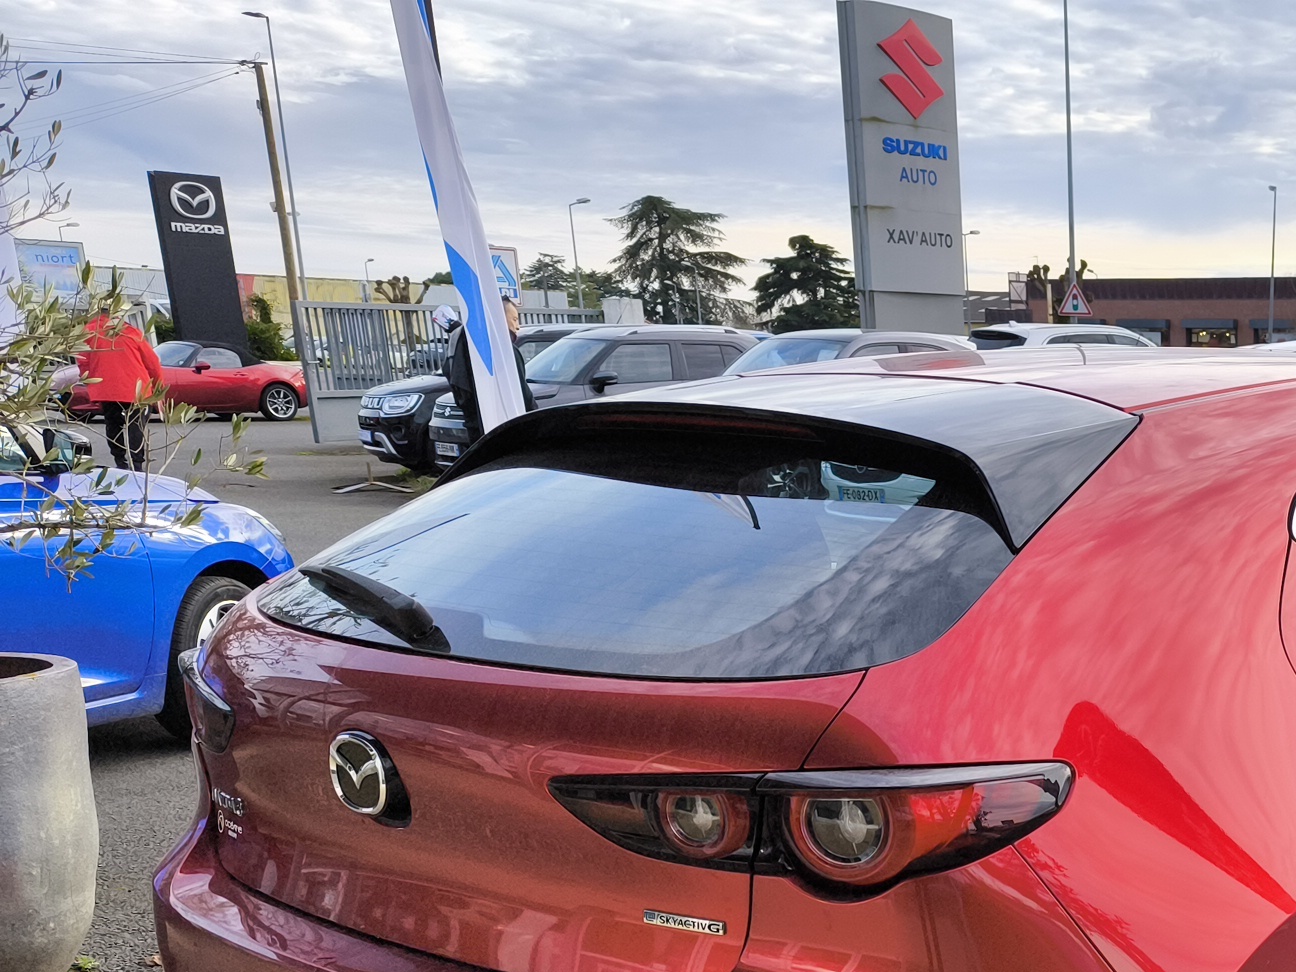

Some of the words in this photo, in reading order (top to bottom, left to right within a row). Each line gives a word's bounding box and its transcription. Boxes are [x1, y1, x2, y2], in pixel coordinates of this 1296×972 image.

[882, 136, 948, 161] SUZUKI
[900, 166, 938, 186] AUTO
[886, 228, 954, 249] XAV'AUTO
[34, 253, 77, 265] niort
